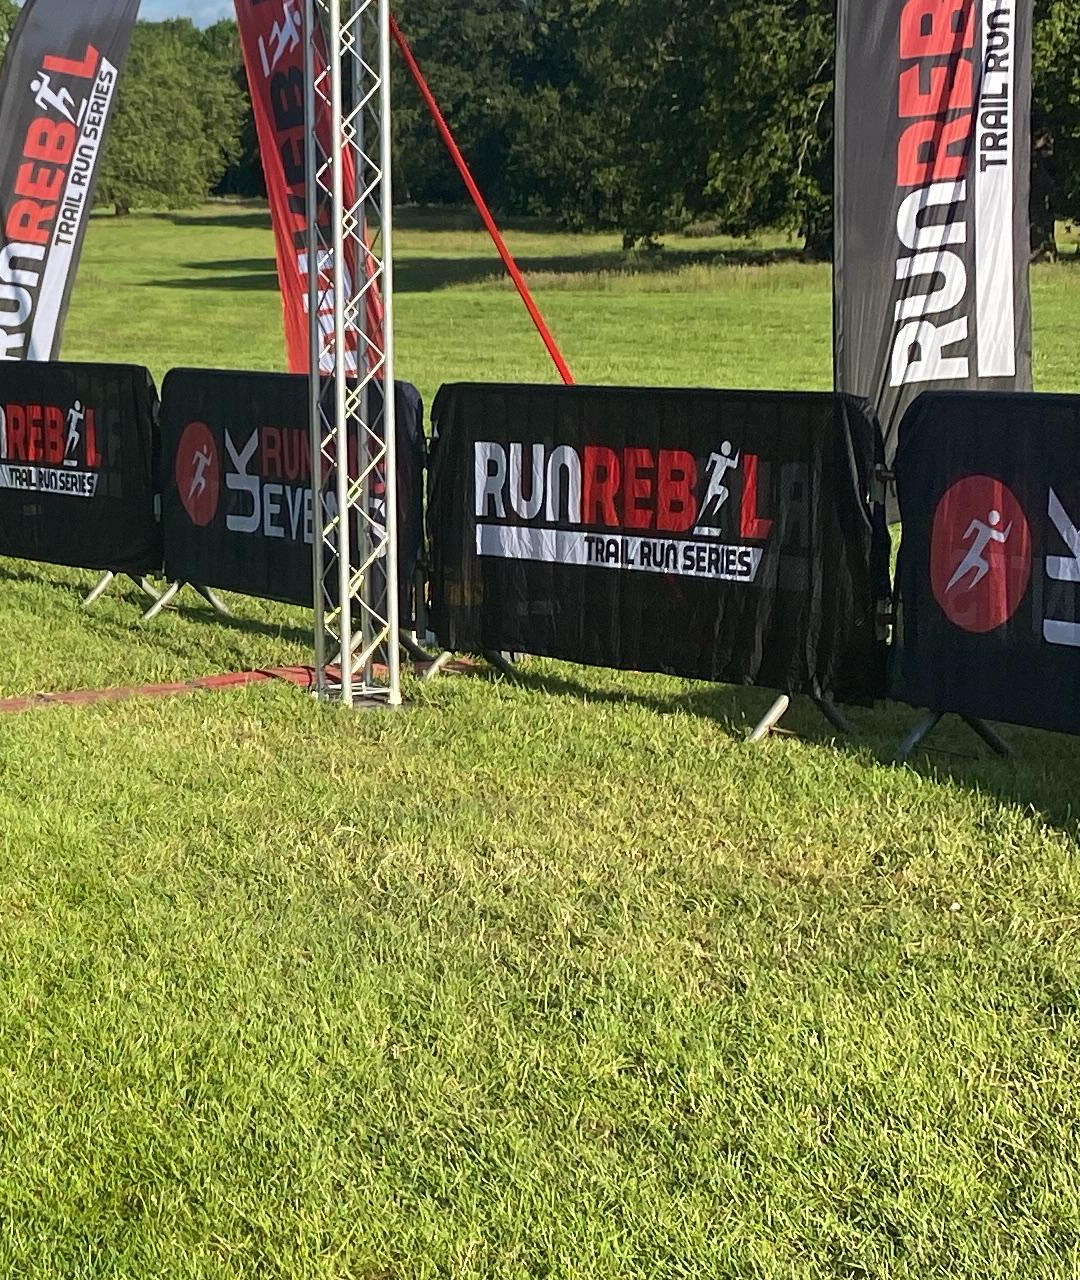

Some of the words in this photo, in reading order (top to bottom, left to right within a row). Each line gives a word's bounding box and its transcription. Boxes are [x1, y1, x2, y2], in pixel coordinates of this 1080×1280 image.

[984, 8, 1010, 73] RUN
[54, 192, 83, 247] TRAIL
[70, 144, 95, 187] RUN
[83, 70, 114, 141] SERIES
[980, 82, 1009, 172] TRAIL
[39, 469, 58, 490] RUN
[59, 472, 95, 494] SERIES
[584, 535, 634, 567] TRAIL
[640, 540, 678, 570] RUN
[683, 546, 751, 577] SERIES
